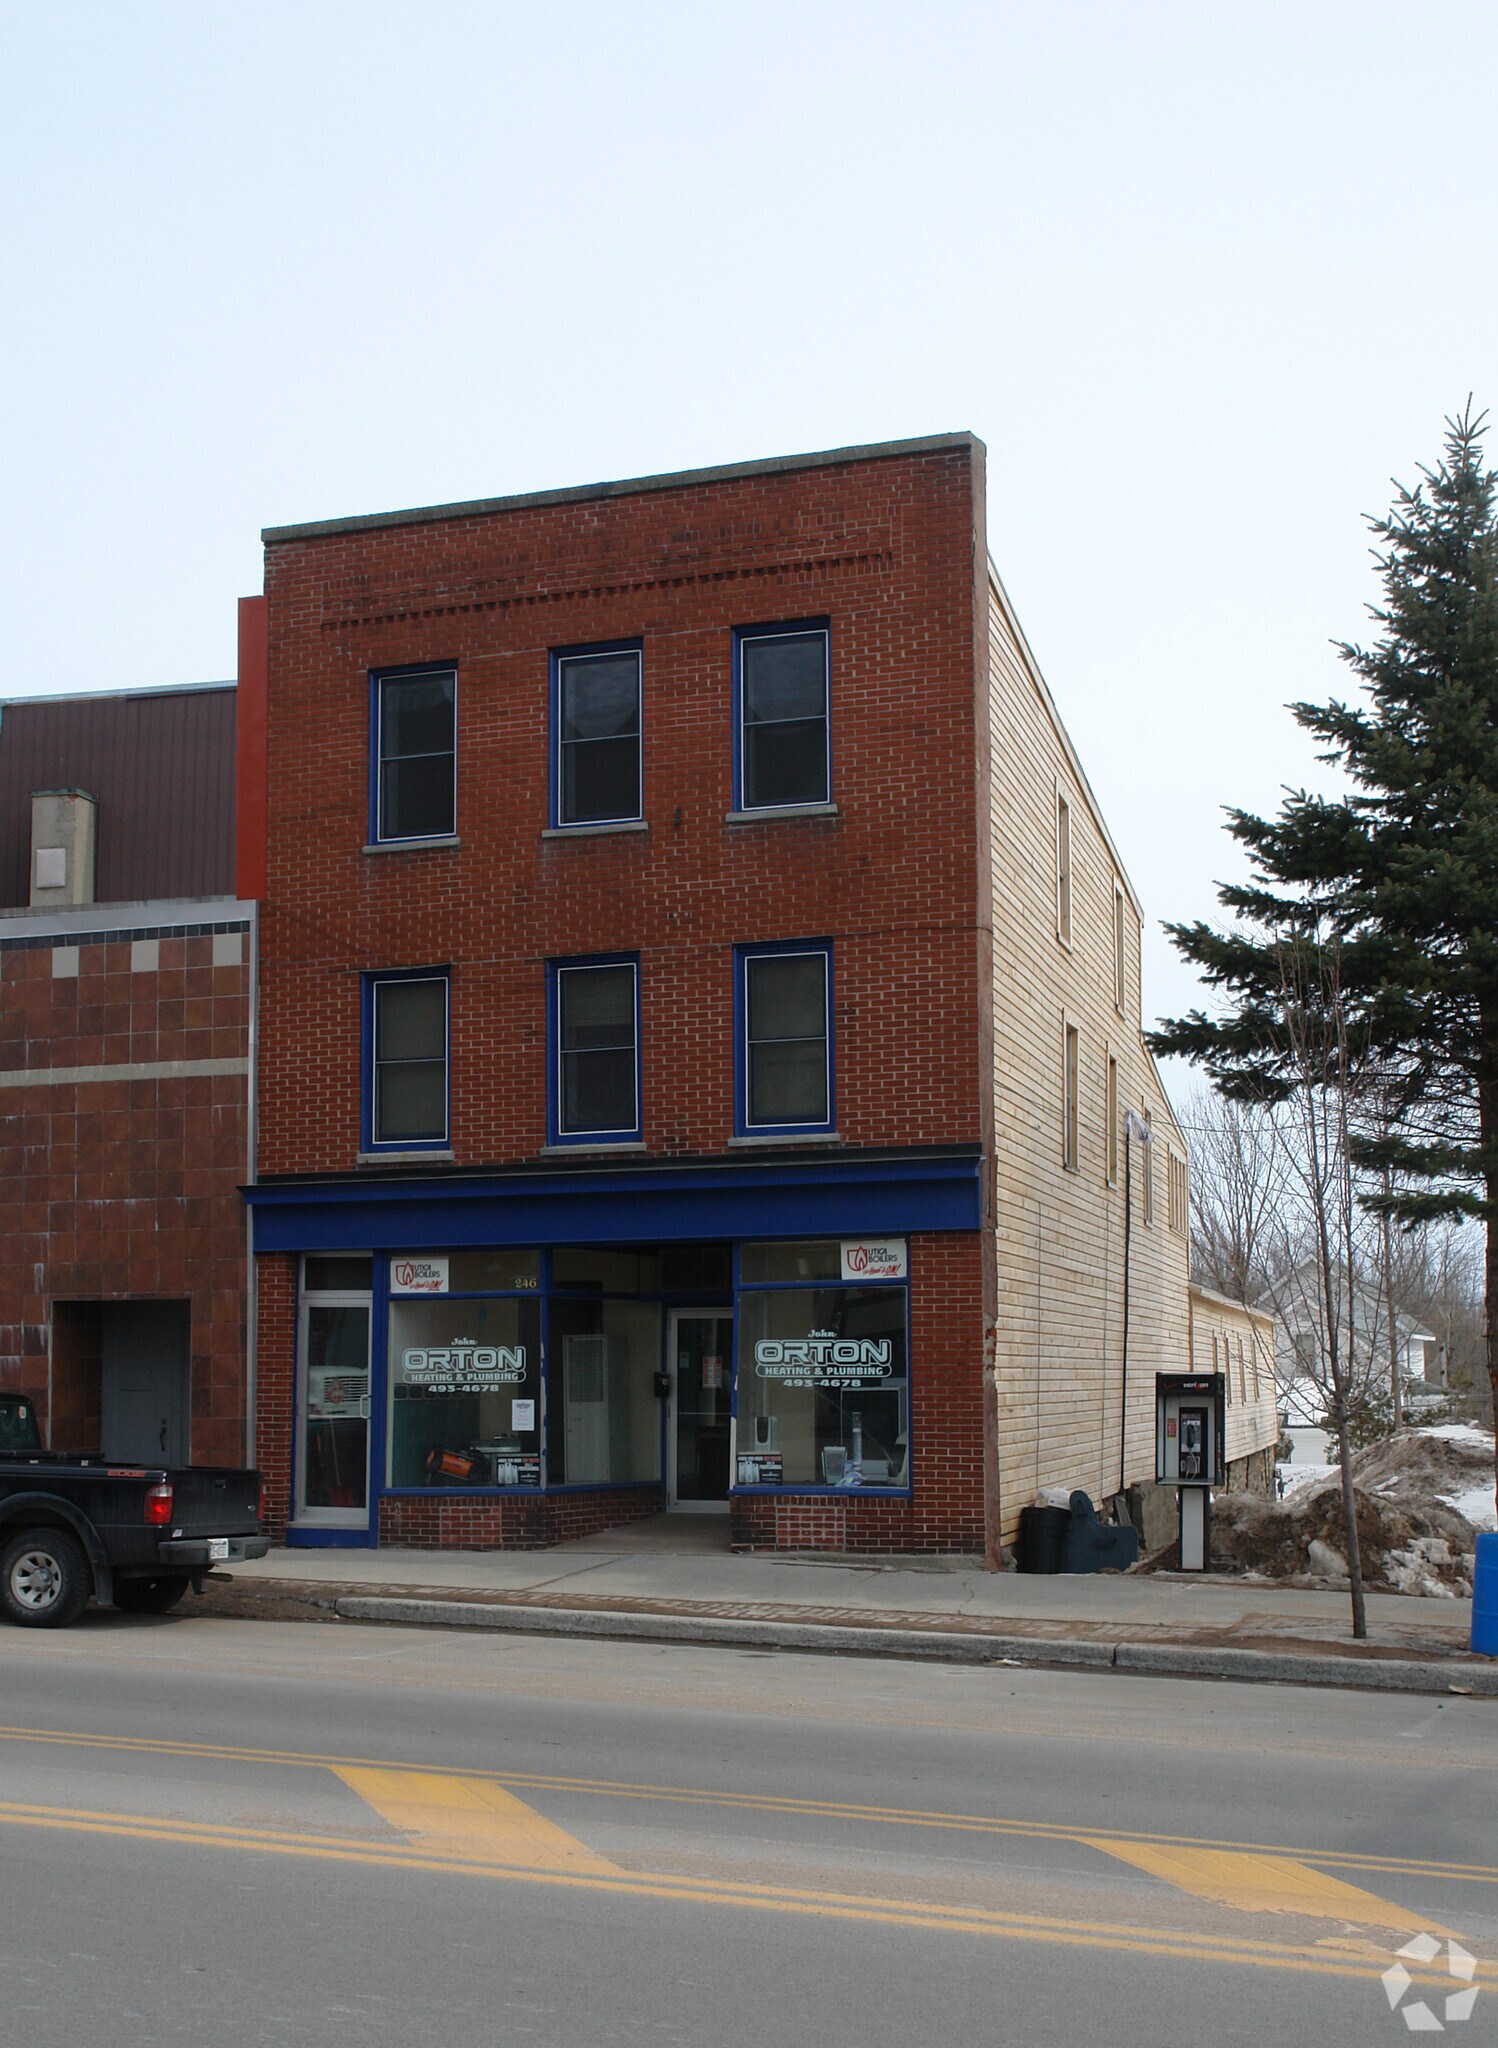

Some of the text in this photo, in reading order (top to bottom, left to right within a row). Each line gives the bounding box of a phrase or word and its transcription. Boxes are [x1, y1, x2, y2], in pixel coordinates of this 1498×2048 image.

[868, 1248, 887, 1256] UTICA
[868, 1255, 898, 1263] BOILERS
[414, 1270, 441, 1278] BOILERS
[514, 1278, 537, 1288] 246
[807, 1329, 837, 1338] John
[451, 1337, 478, 1346] John
[756, 1341, 890, 1364] ORTON
[403, 1348, 524, 1371] ORTON
[765, 1367, 884, 1375] HEATING & PLUMBING
[411, 1372, 519, 1381] HEATING & PLUMBING
[783, 1379, 862, 1387] 493-4678
[428, 1384, 499, 1393] 493-4678
